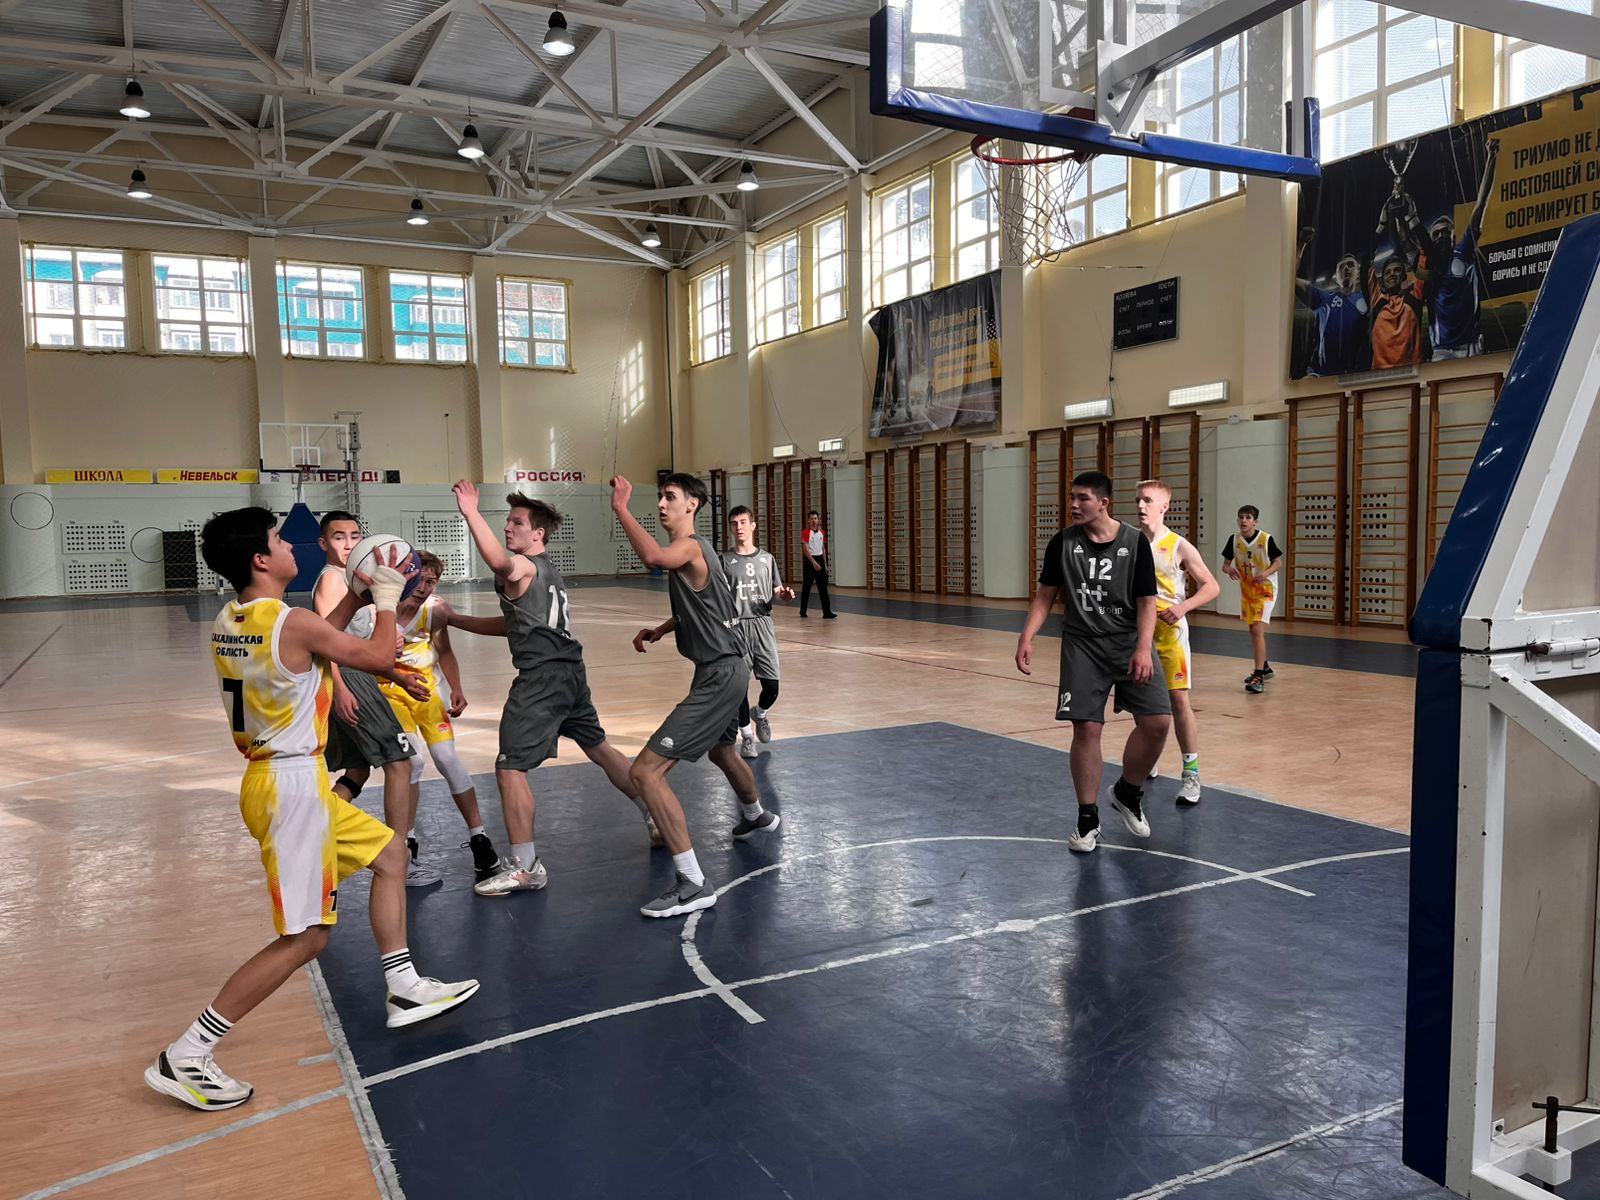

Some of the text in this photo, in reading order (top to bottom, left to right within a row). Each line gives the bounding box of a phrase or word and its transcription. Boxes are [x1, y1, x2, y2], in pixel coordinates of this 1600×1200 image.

[1513, 137, 1570, 170] ТРИУМФ
[1575, 131, 1592, 154] НЕ
[1501, 159, 1581, 203] НАСТОЯЩЕЙ
[1505, 192, 1588, 230] ФОРМИРУЕТ
[1488, 248, 1516, 264] БОРЬБА
[1517, 247, 1523, 258] С
[1492, 265, 1521, 281] БОРИСЬ
[1521, 264, 1527, 276] И
[1528, 262, 1537, 274] НЕ
[73, 470, 124, 481] ШКОЛА
[515, 471, 583, 482] РОССИЯ
[746, 563, 756, 576] 8
[1088, 557, 1113, 580] 12
[397, 733, 410, 753] 5
